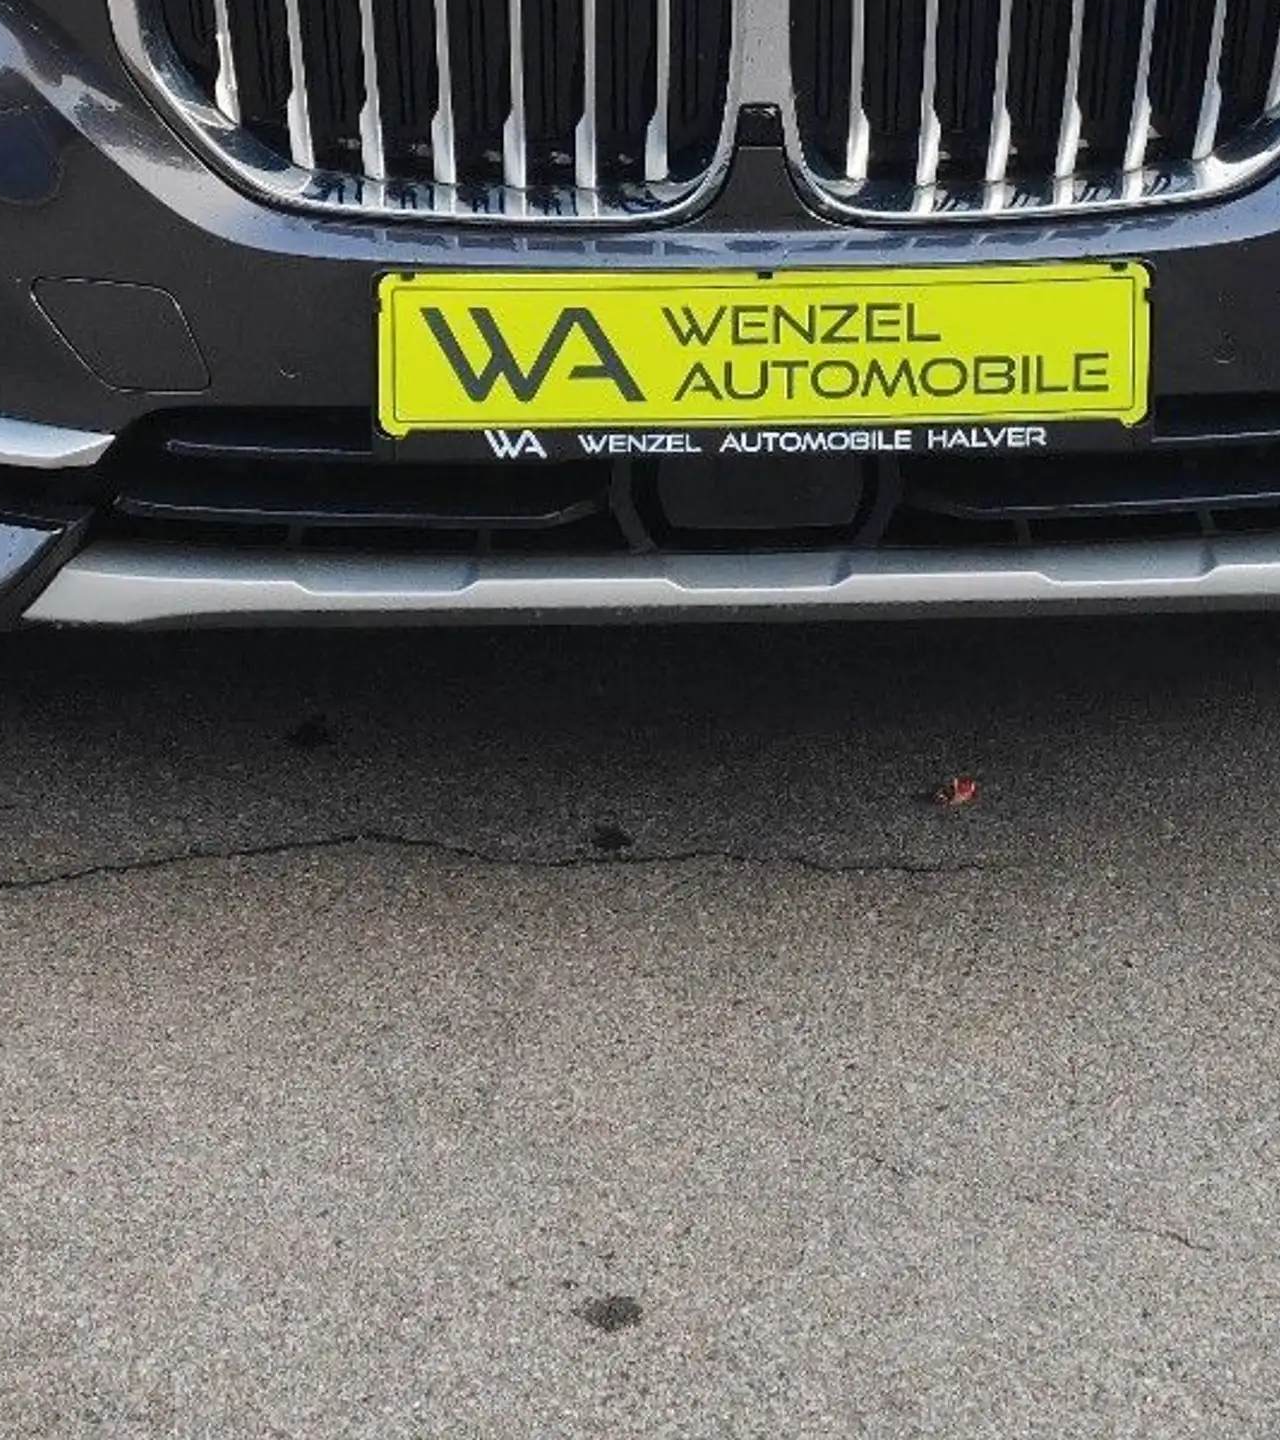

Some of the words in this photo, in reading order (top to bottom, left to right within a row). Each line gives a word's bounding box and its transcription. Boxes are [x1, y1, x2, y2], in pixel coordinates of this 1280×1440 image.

[660, 303, 941, 347] WENZEL
[419, 306, 648, 403] WA
[673, 352, 1110, 403] AUTOMOBILE
[483, 429, 548, 460] WA
[577, 433, 702, 454] WENZEL
[718, 429, 913, 454] AUTOMOBILE
[927, 426, 1047, 449] HALVER
